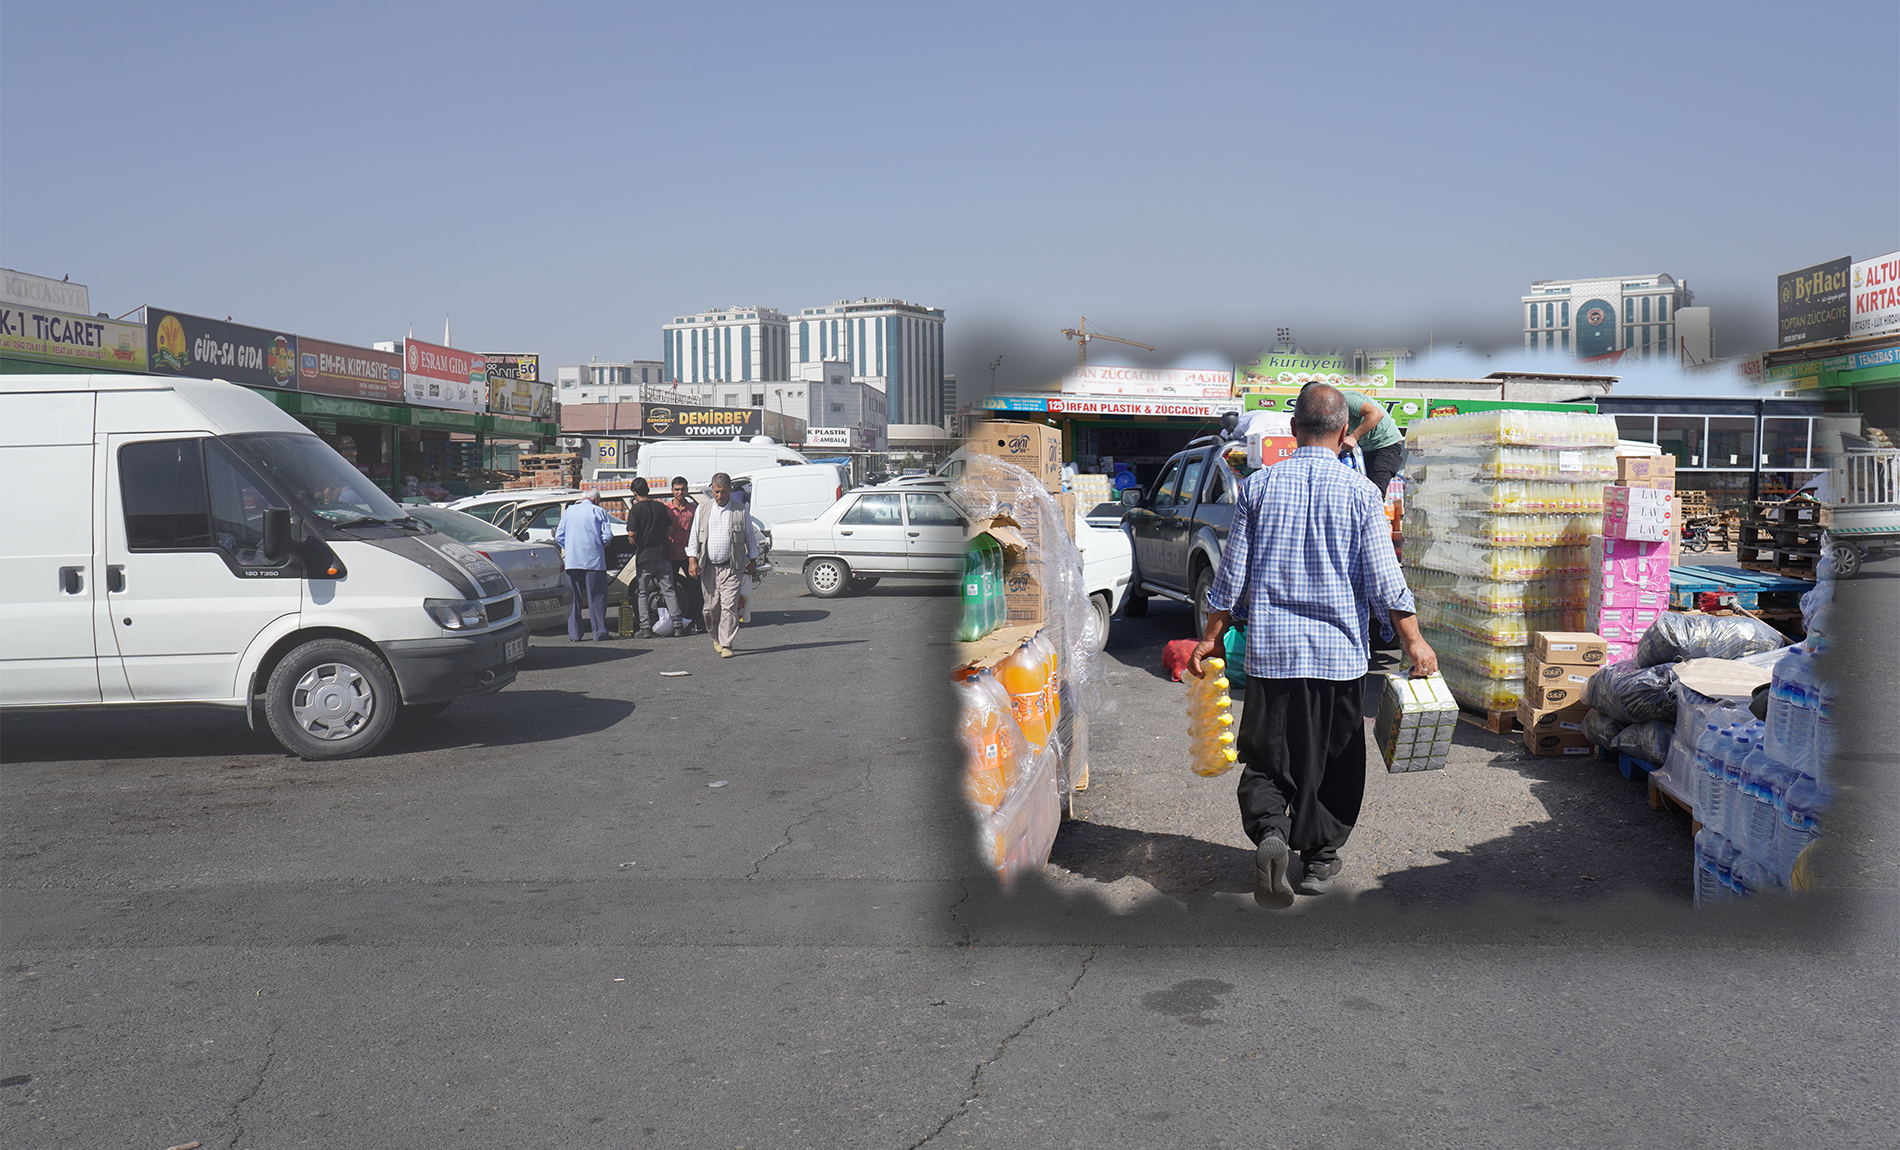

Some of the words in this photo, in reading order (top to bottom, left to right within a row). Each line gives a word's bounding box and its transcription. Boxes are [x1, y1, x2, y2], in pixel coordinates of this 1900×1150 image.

[1866, 259, 1900, 287] ALTU
[1781, 315, 1806, 330] TOPTAN
[194, 334, 234, 366] GÜR-SA
[237, 345, 263, 370] GIDA
[320, 353, 347, 374] EM-FA
[421, 351, 448, 373] EŞRAM
[449, 357, 468, 375] GIDA
[520, 363, 536, 374] 50
[1101, 368, 1163, 381] ZÜCCACİYE
[1168, 373, 1180, 381] ve
[1185, 371, 1229, 383] PLASTİK
[1772, 365, 1793, 379] YILDIZ
[1048, 401, 1063, 410] 125
[1067, 401, 1097, 411] İRFAN
[1101, 403, 1142, 413] PLASTİK
[1144, 405, 1151, 414] &
[1155, 403, 1210, 415] ZÜCCACİYE
[679, 409, 752, 425] DEMİRBEY
[685, 425, 743, 435] OTOMOTİV
[600, 447, 616, 457] 50
